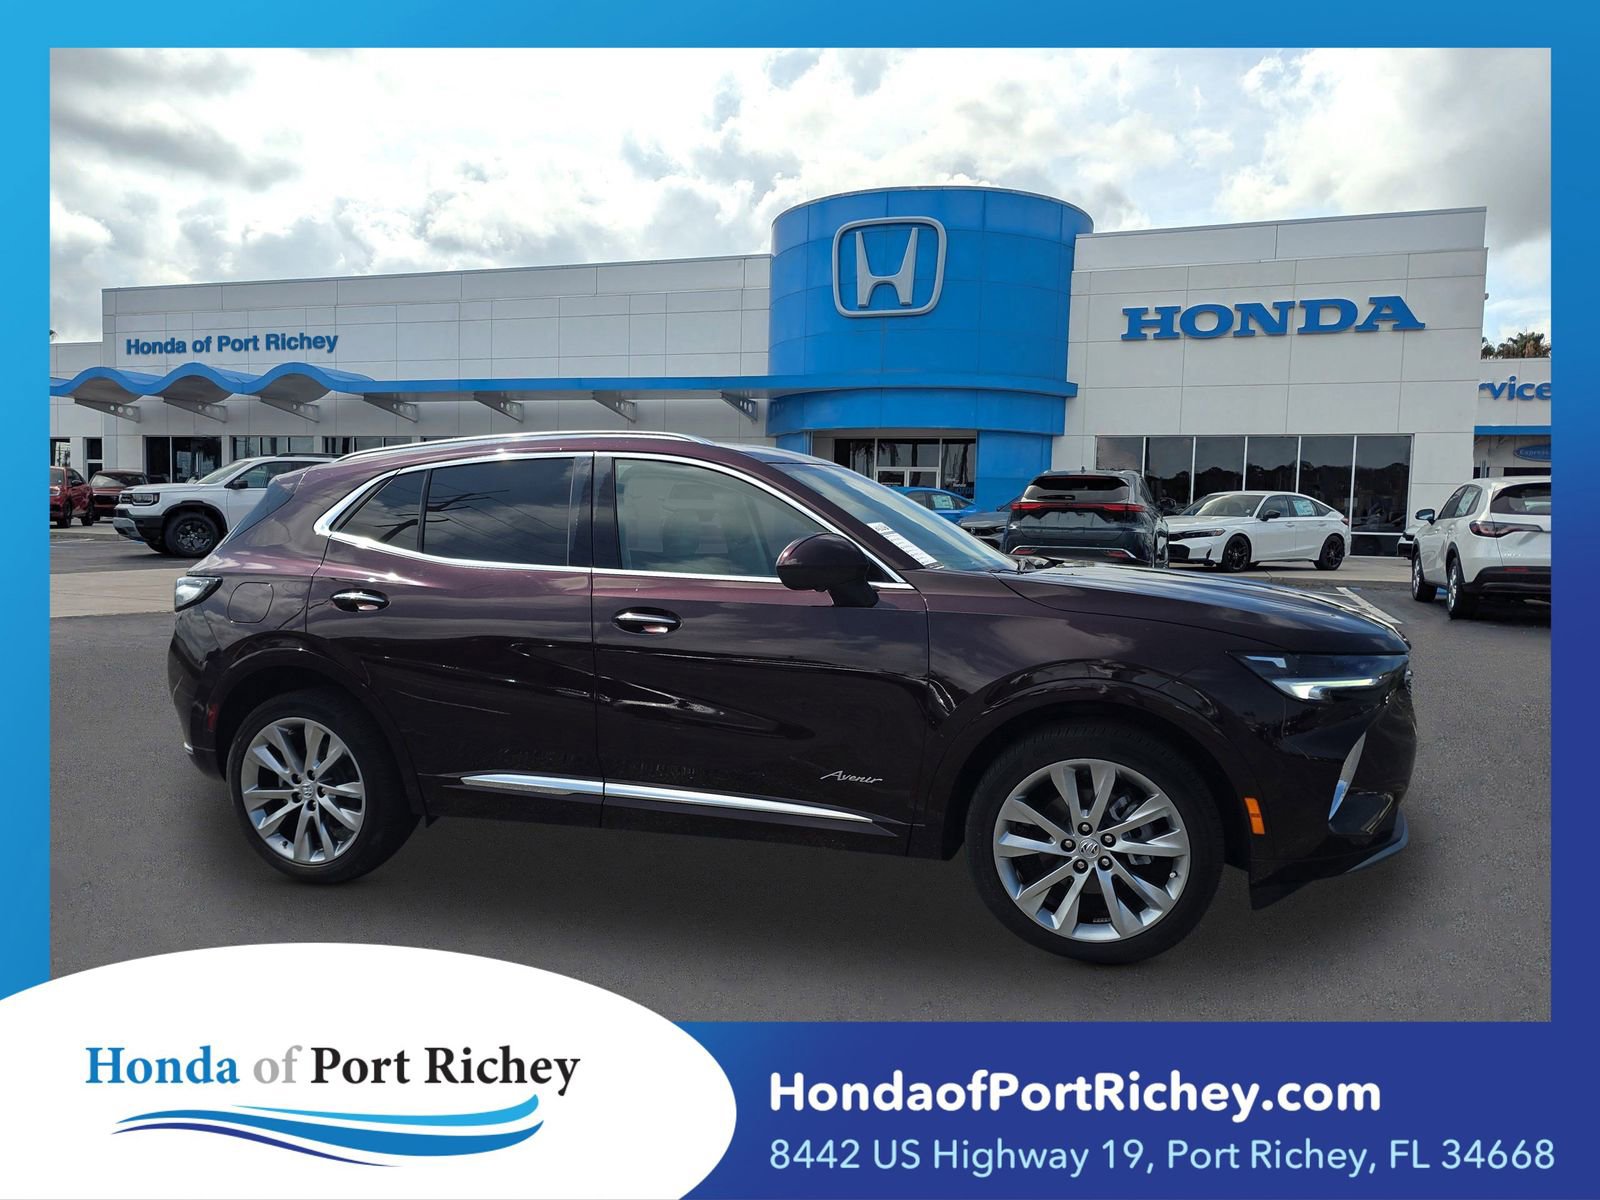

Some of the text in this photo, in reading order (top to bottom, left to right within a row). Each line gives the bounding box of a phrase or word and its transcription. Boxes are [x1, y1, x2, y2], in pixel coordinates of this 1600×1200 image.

[1121, 295, 1426, 341] HONDA
[126, 332, 339, 355] Honda of Port Richey
[820, 770, 883, 784] Avenir
